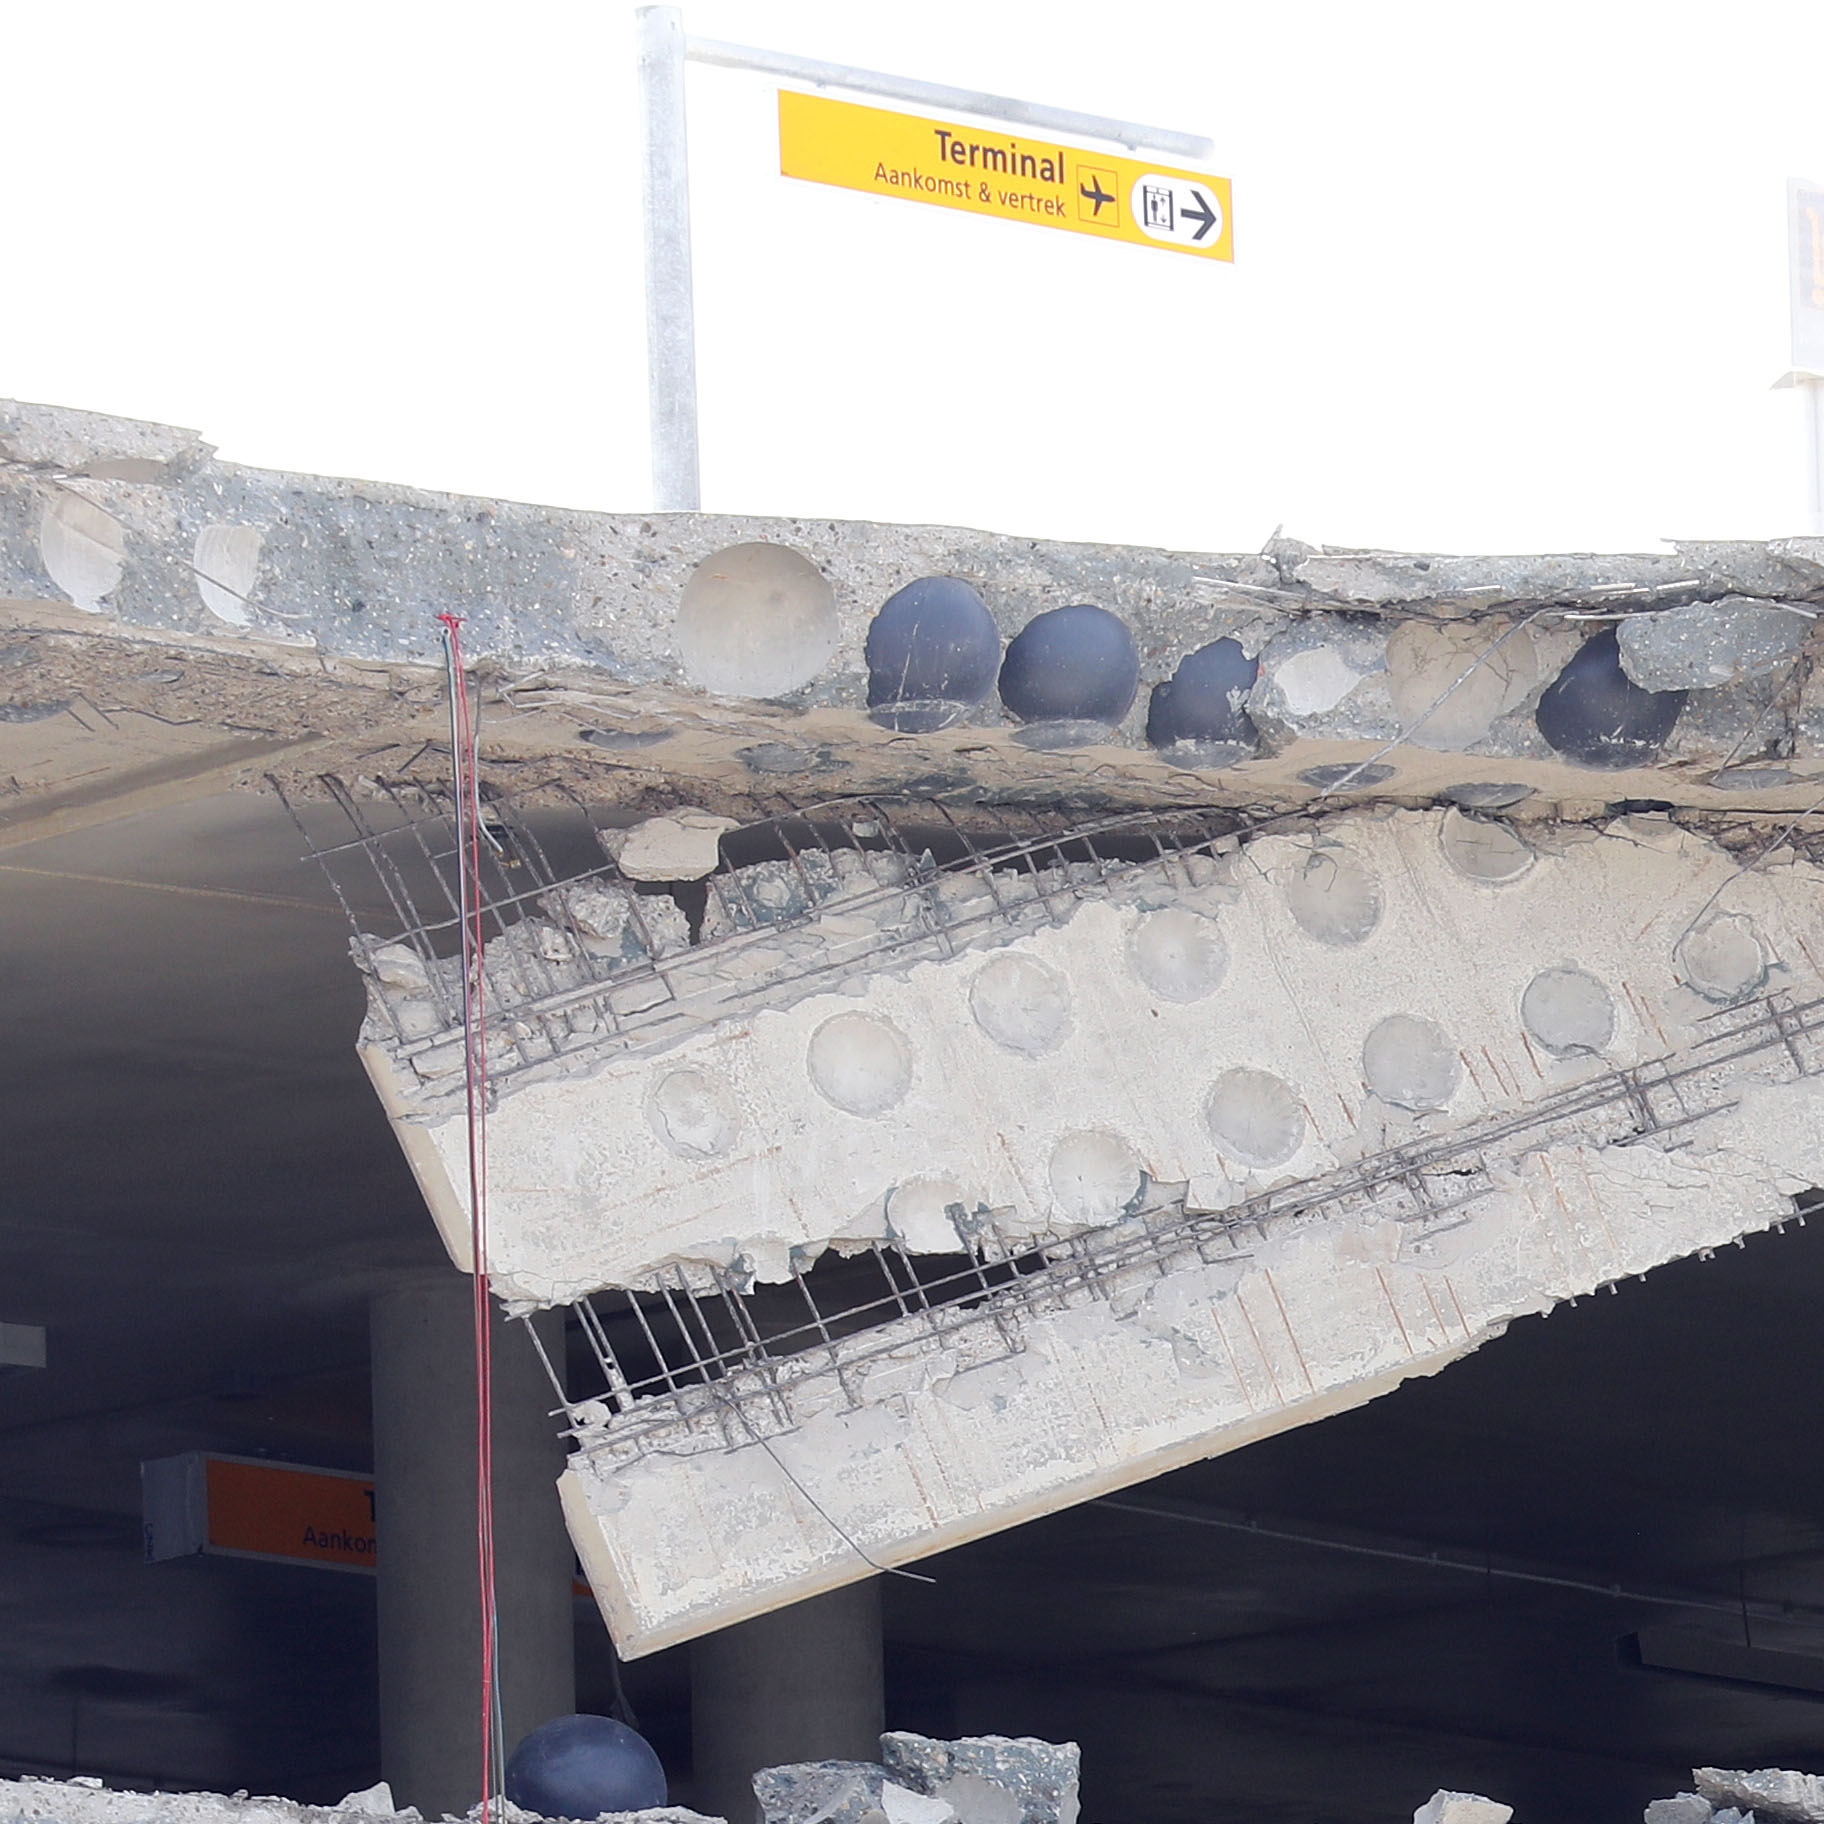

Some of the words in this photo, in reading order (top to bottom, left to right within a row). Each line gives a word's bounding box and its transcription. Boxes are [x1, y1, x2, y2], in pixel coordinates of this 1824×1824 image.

[935, 130, 1063, 183] Terminal
[875, 163, 970, 198] Aankomst
[979, 183, 990, 202] &
[999, 192, 1064, 216] vertrek
[304, 1526, 377, 1554] Aanko
